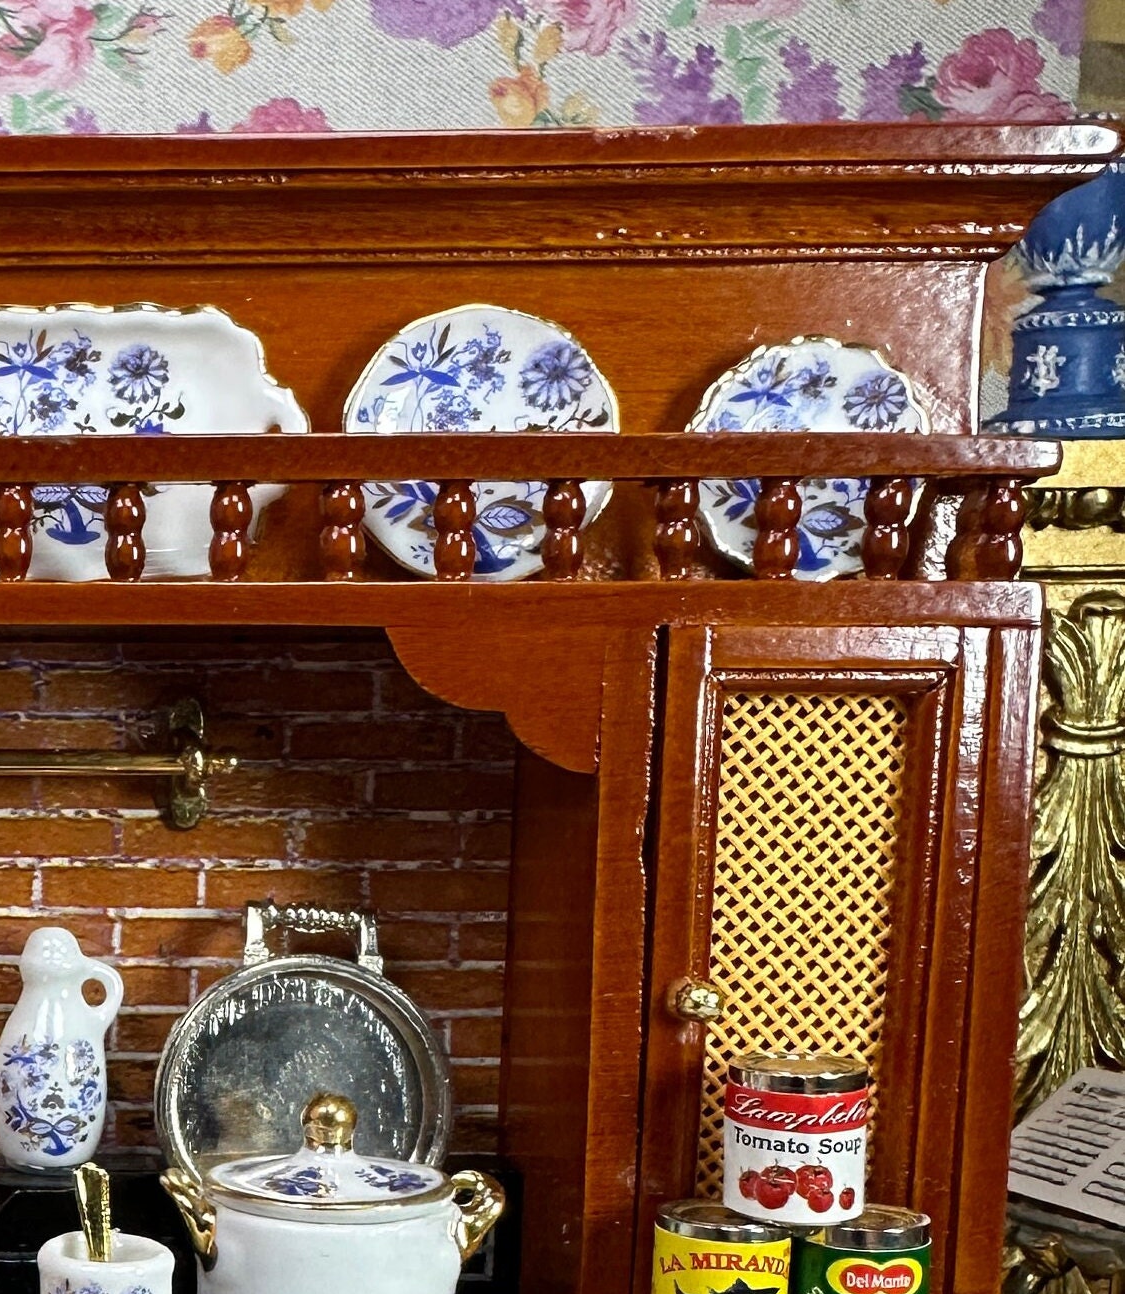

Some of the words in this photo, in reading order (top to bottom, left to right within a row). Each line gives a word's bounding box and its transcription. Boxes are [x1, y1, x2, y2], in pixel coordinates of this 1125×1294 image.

[733, 1125, 810, 1155] Tomato
[818, 1137, 862, 1155] Soup
[659, 1254, 686, 1275] LA
[846, 1271, 869, 1289] Del
